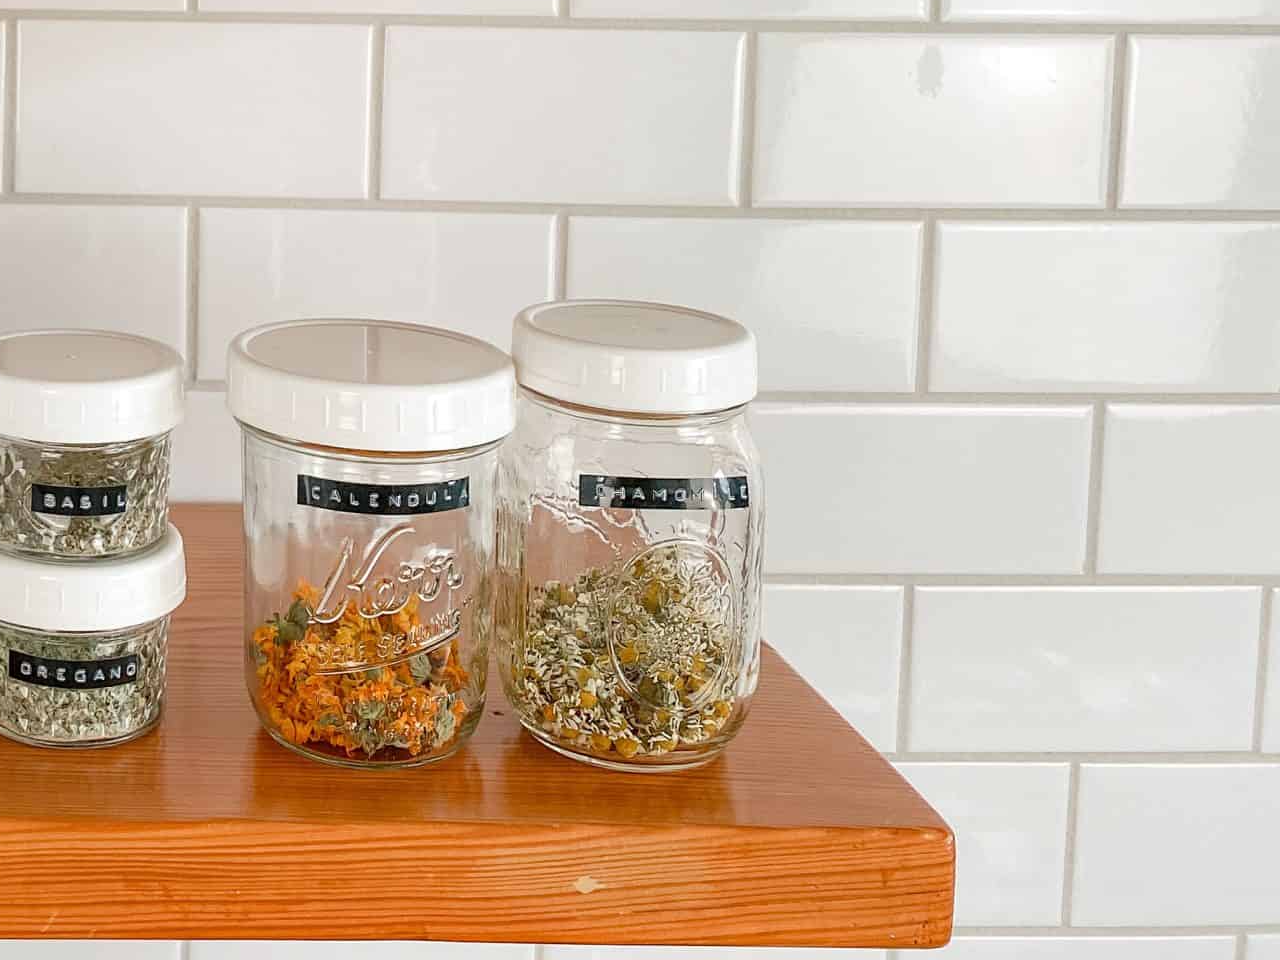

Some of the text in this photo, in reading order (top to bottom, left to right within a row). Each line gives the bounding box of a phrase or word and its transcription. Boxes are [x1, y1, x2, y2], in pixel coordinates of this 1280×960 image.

[43, 493, 125, 509] BASIL
[311, 480, 469, 508] CALENDULA
[20, 662, 136, 683] OREGANO
